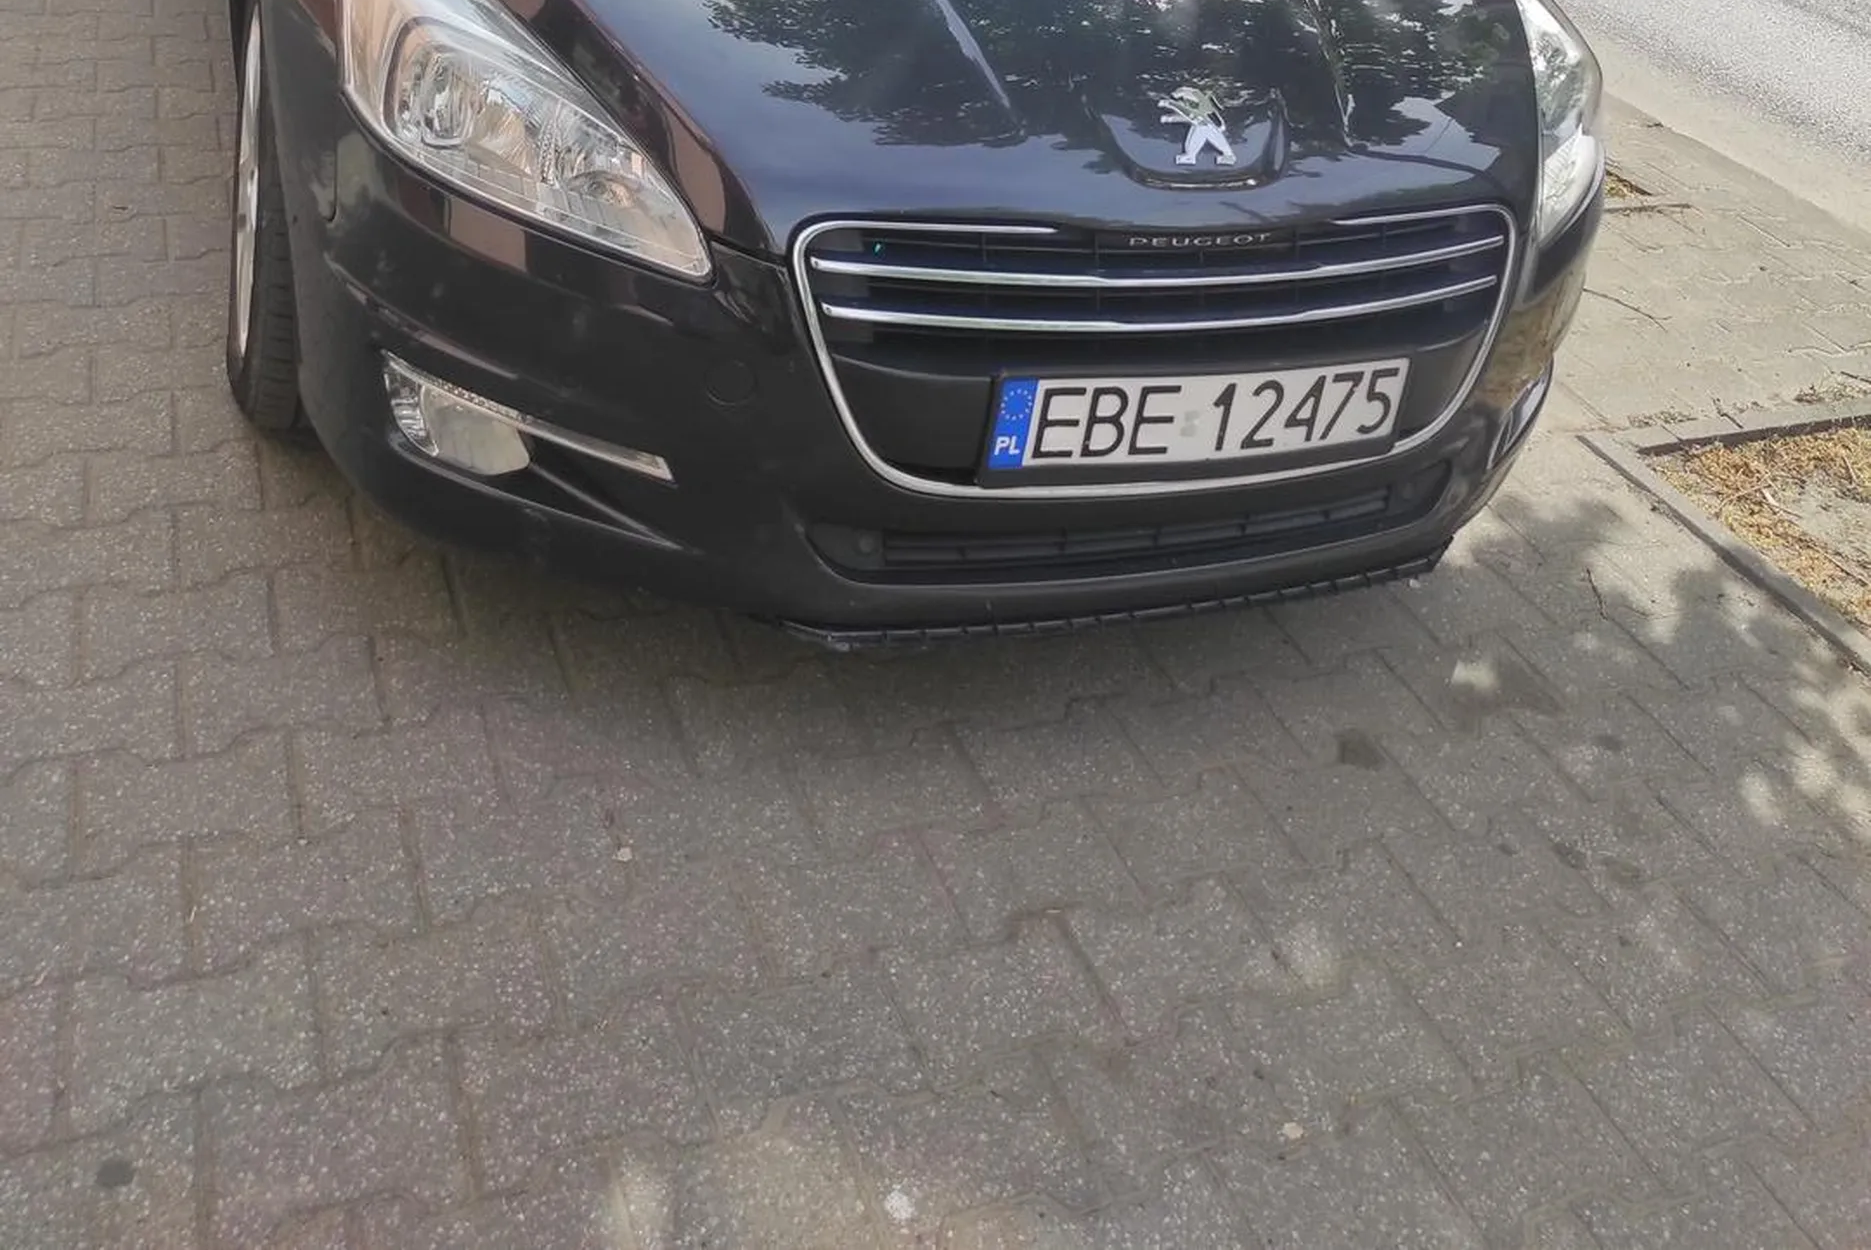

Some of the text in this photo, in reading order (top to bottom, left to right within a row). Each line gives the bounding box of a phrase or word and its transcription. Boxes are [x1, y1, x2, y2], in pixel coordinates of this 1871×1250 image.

[1128, 232, 1272, 248] PEUGEOT
[1032, 366, 1399, 459] EBE 12475
[994, 435, 1021, 456] PL
